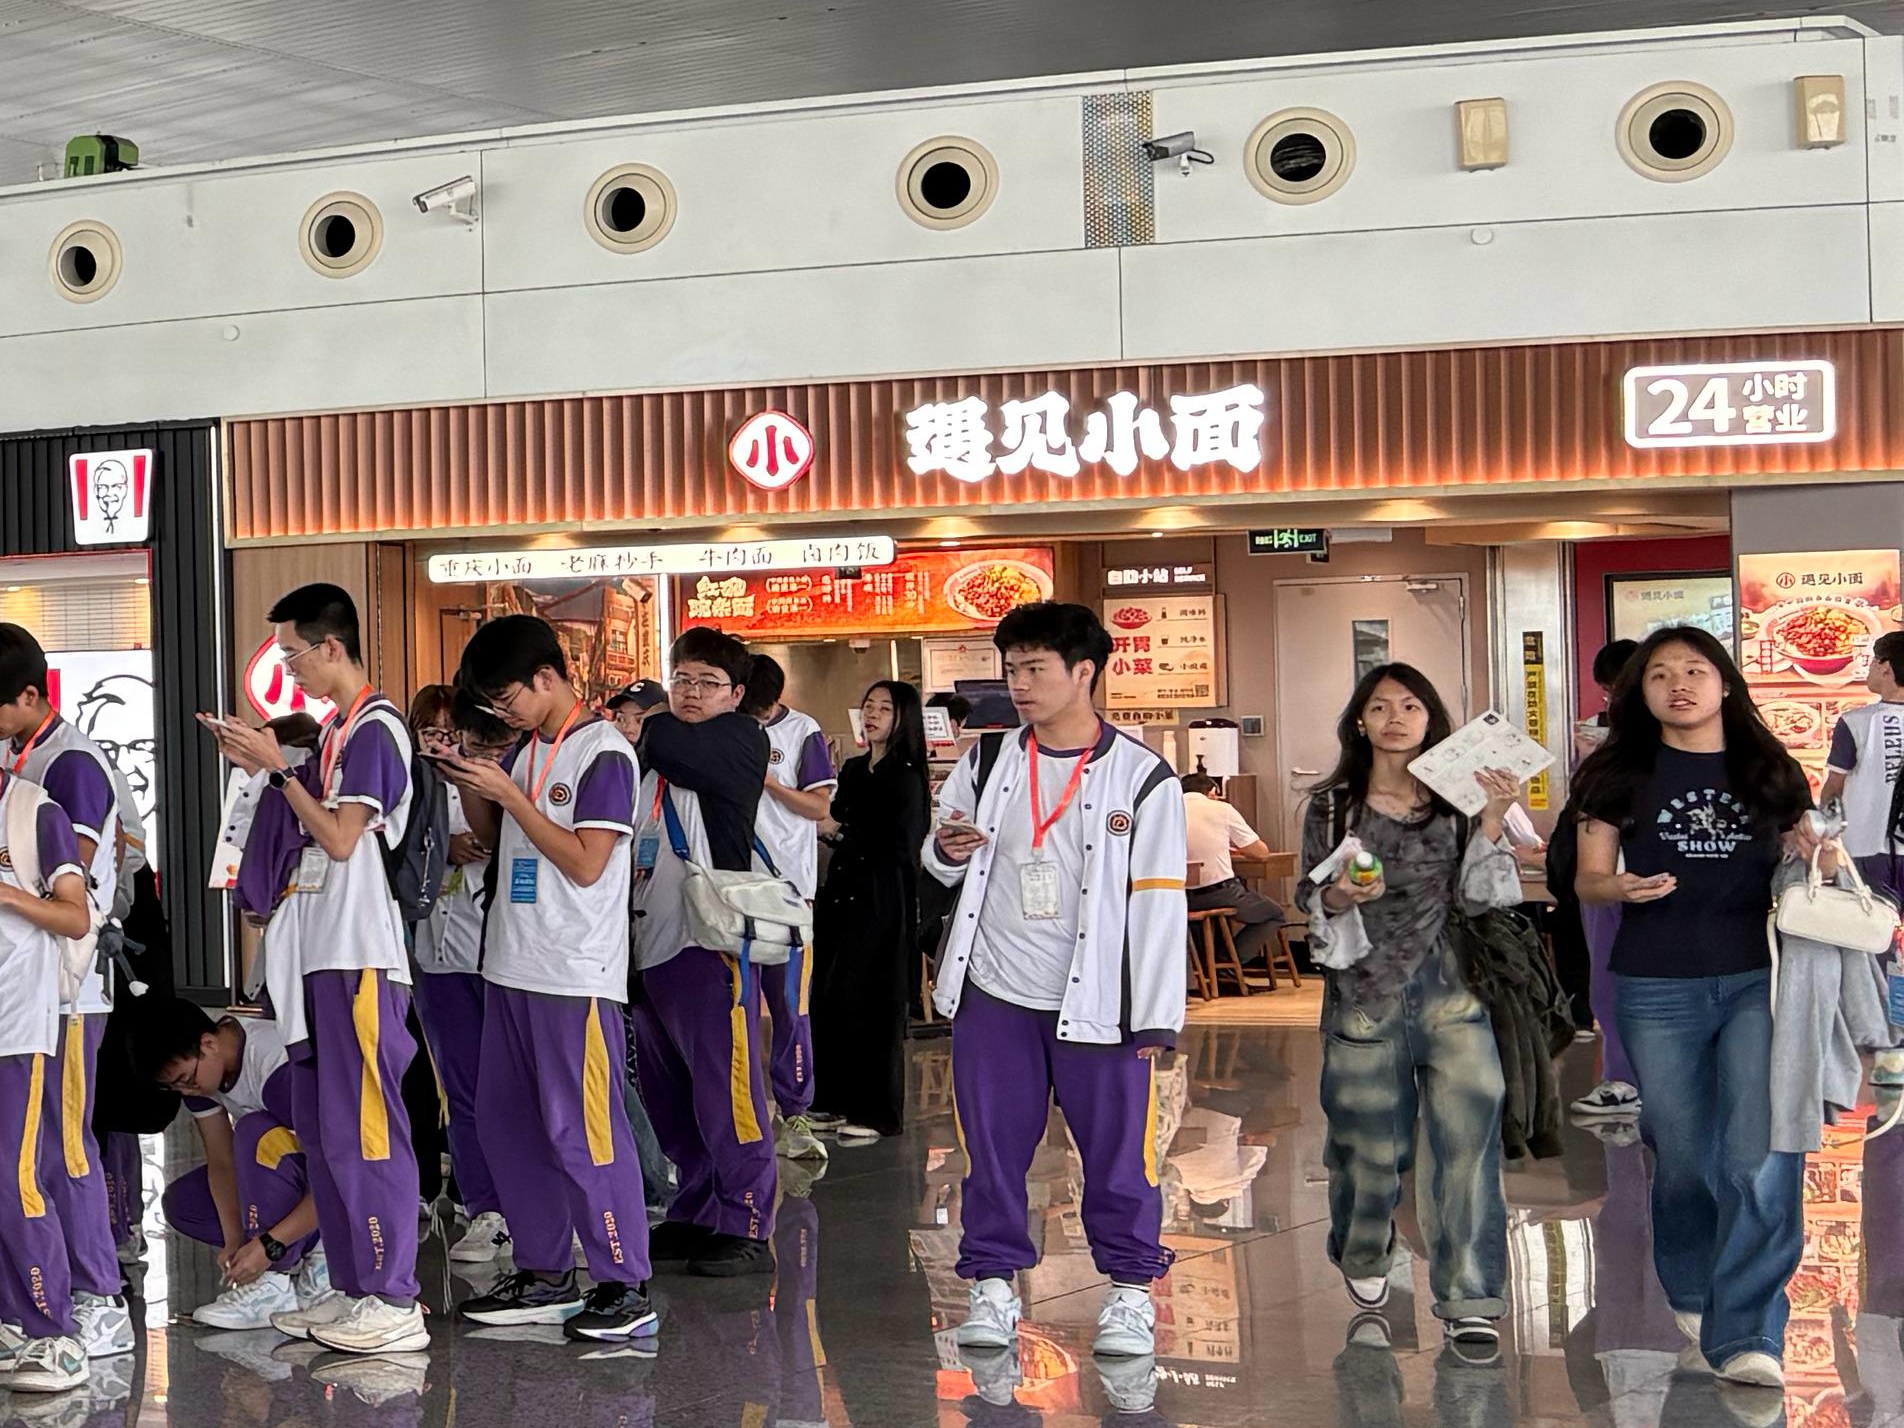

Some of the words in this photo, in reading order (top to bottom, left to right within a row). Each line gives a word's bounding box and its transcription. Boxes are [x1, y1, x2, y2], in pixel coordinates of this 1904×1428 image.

[1647, 377, 1737, 435] 24
[1742, 372, 1808, 402] 小时
[1742, 403, 1809, 434] 营业
[905, 383, 1267, 483] 遇见小面
[698, 546, 773, 568] 牛肉面
[1677, 840, 1737, 852] SHOW
